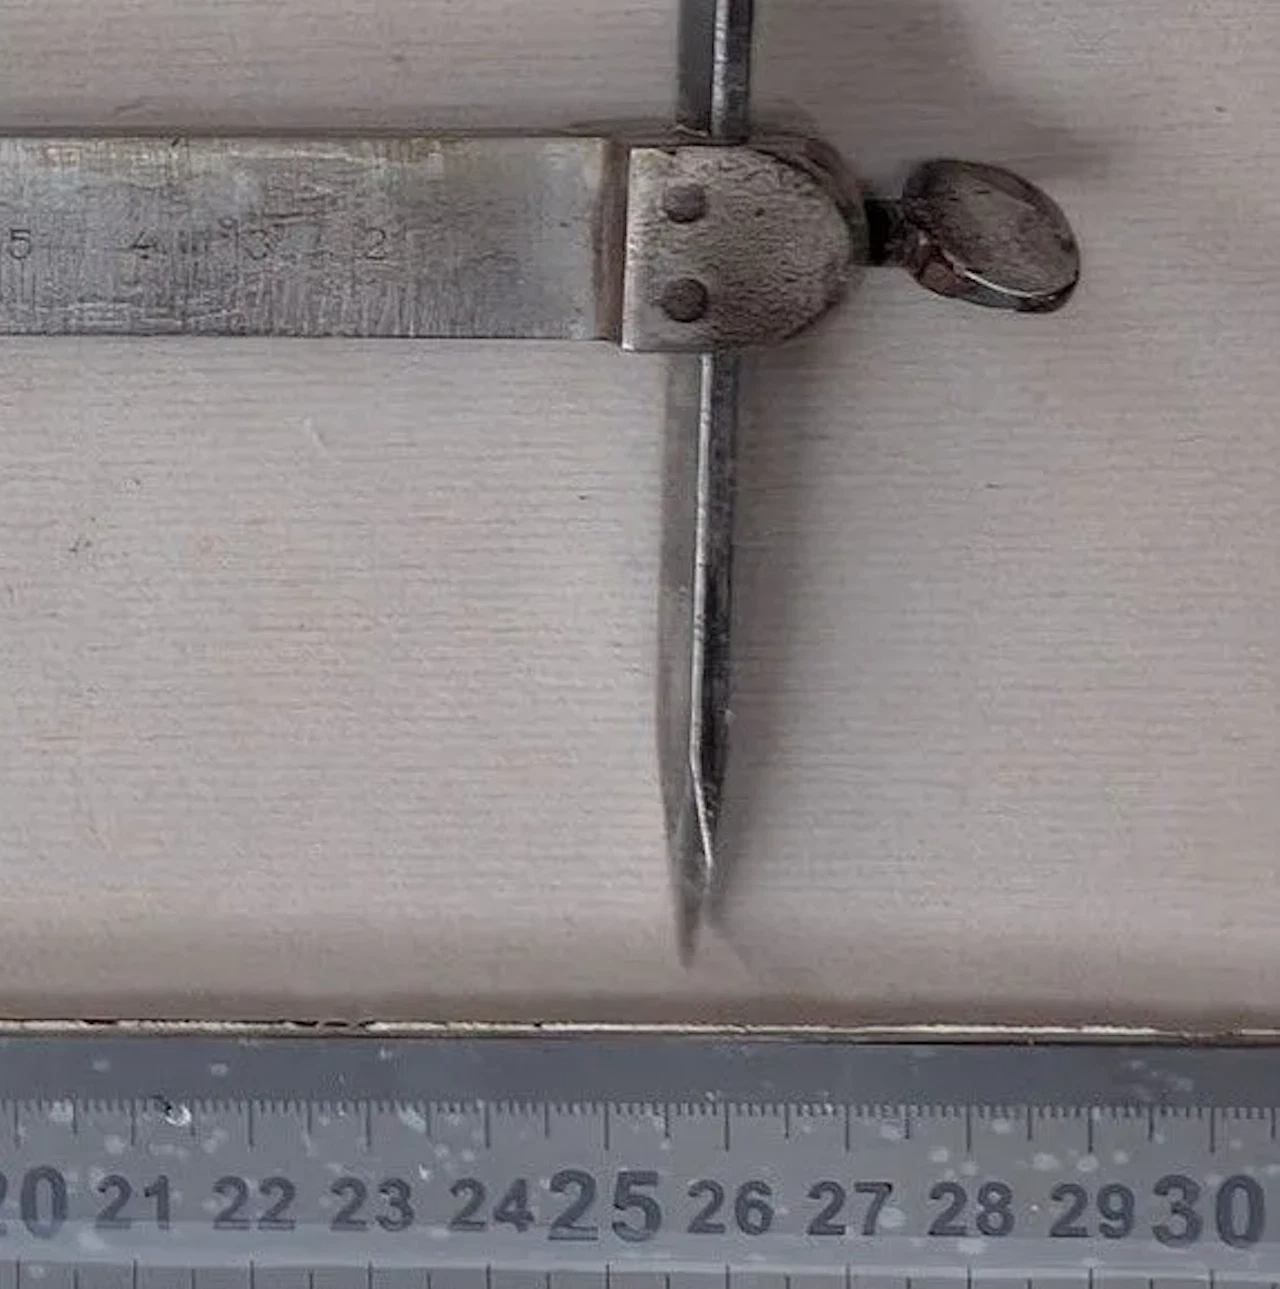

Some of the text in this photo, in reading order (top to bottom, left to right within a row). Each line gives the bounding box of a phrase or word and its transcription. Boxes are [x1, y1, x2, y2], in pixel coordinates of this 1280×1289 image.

[8, 227, 32, 259] 5
[364, 225, 388, 260] 2
[95, 1175, 170, 1230] 21
[213, 1177, 297, 1231] 22
[331, 1178, 413, 1231] 23
[449, 1178, 534, 1233] 24
[548, 1169, 662, 1241] 25
[687, 1180, 775, 1235] 26
[807, 1181, 893, 1236] 27
[928, 1181, 1014, 1237] 28
[1049, 1182, 1135, 1238] 29
[1151, 1174, 1264, 1248] 30
